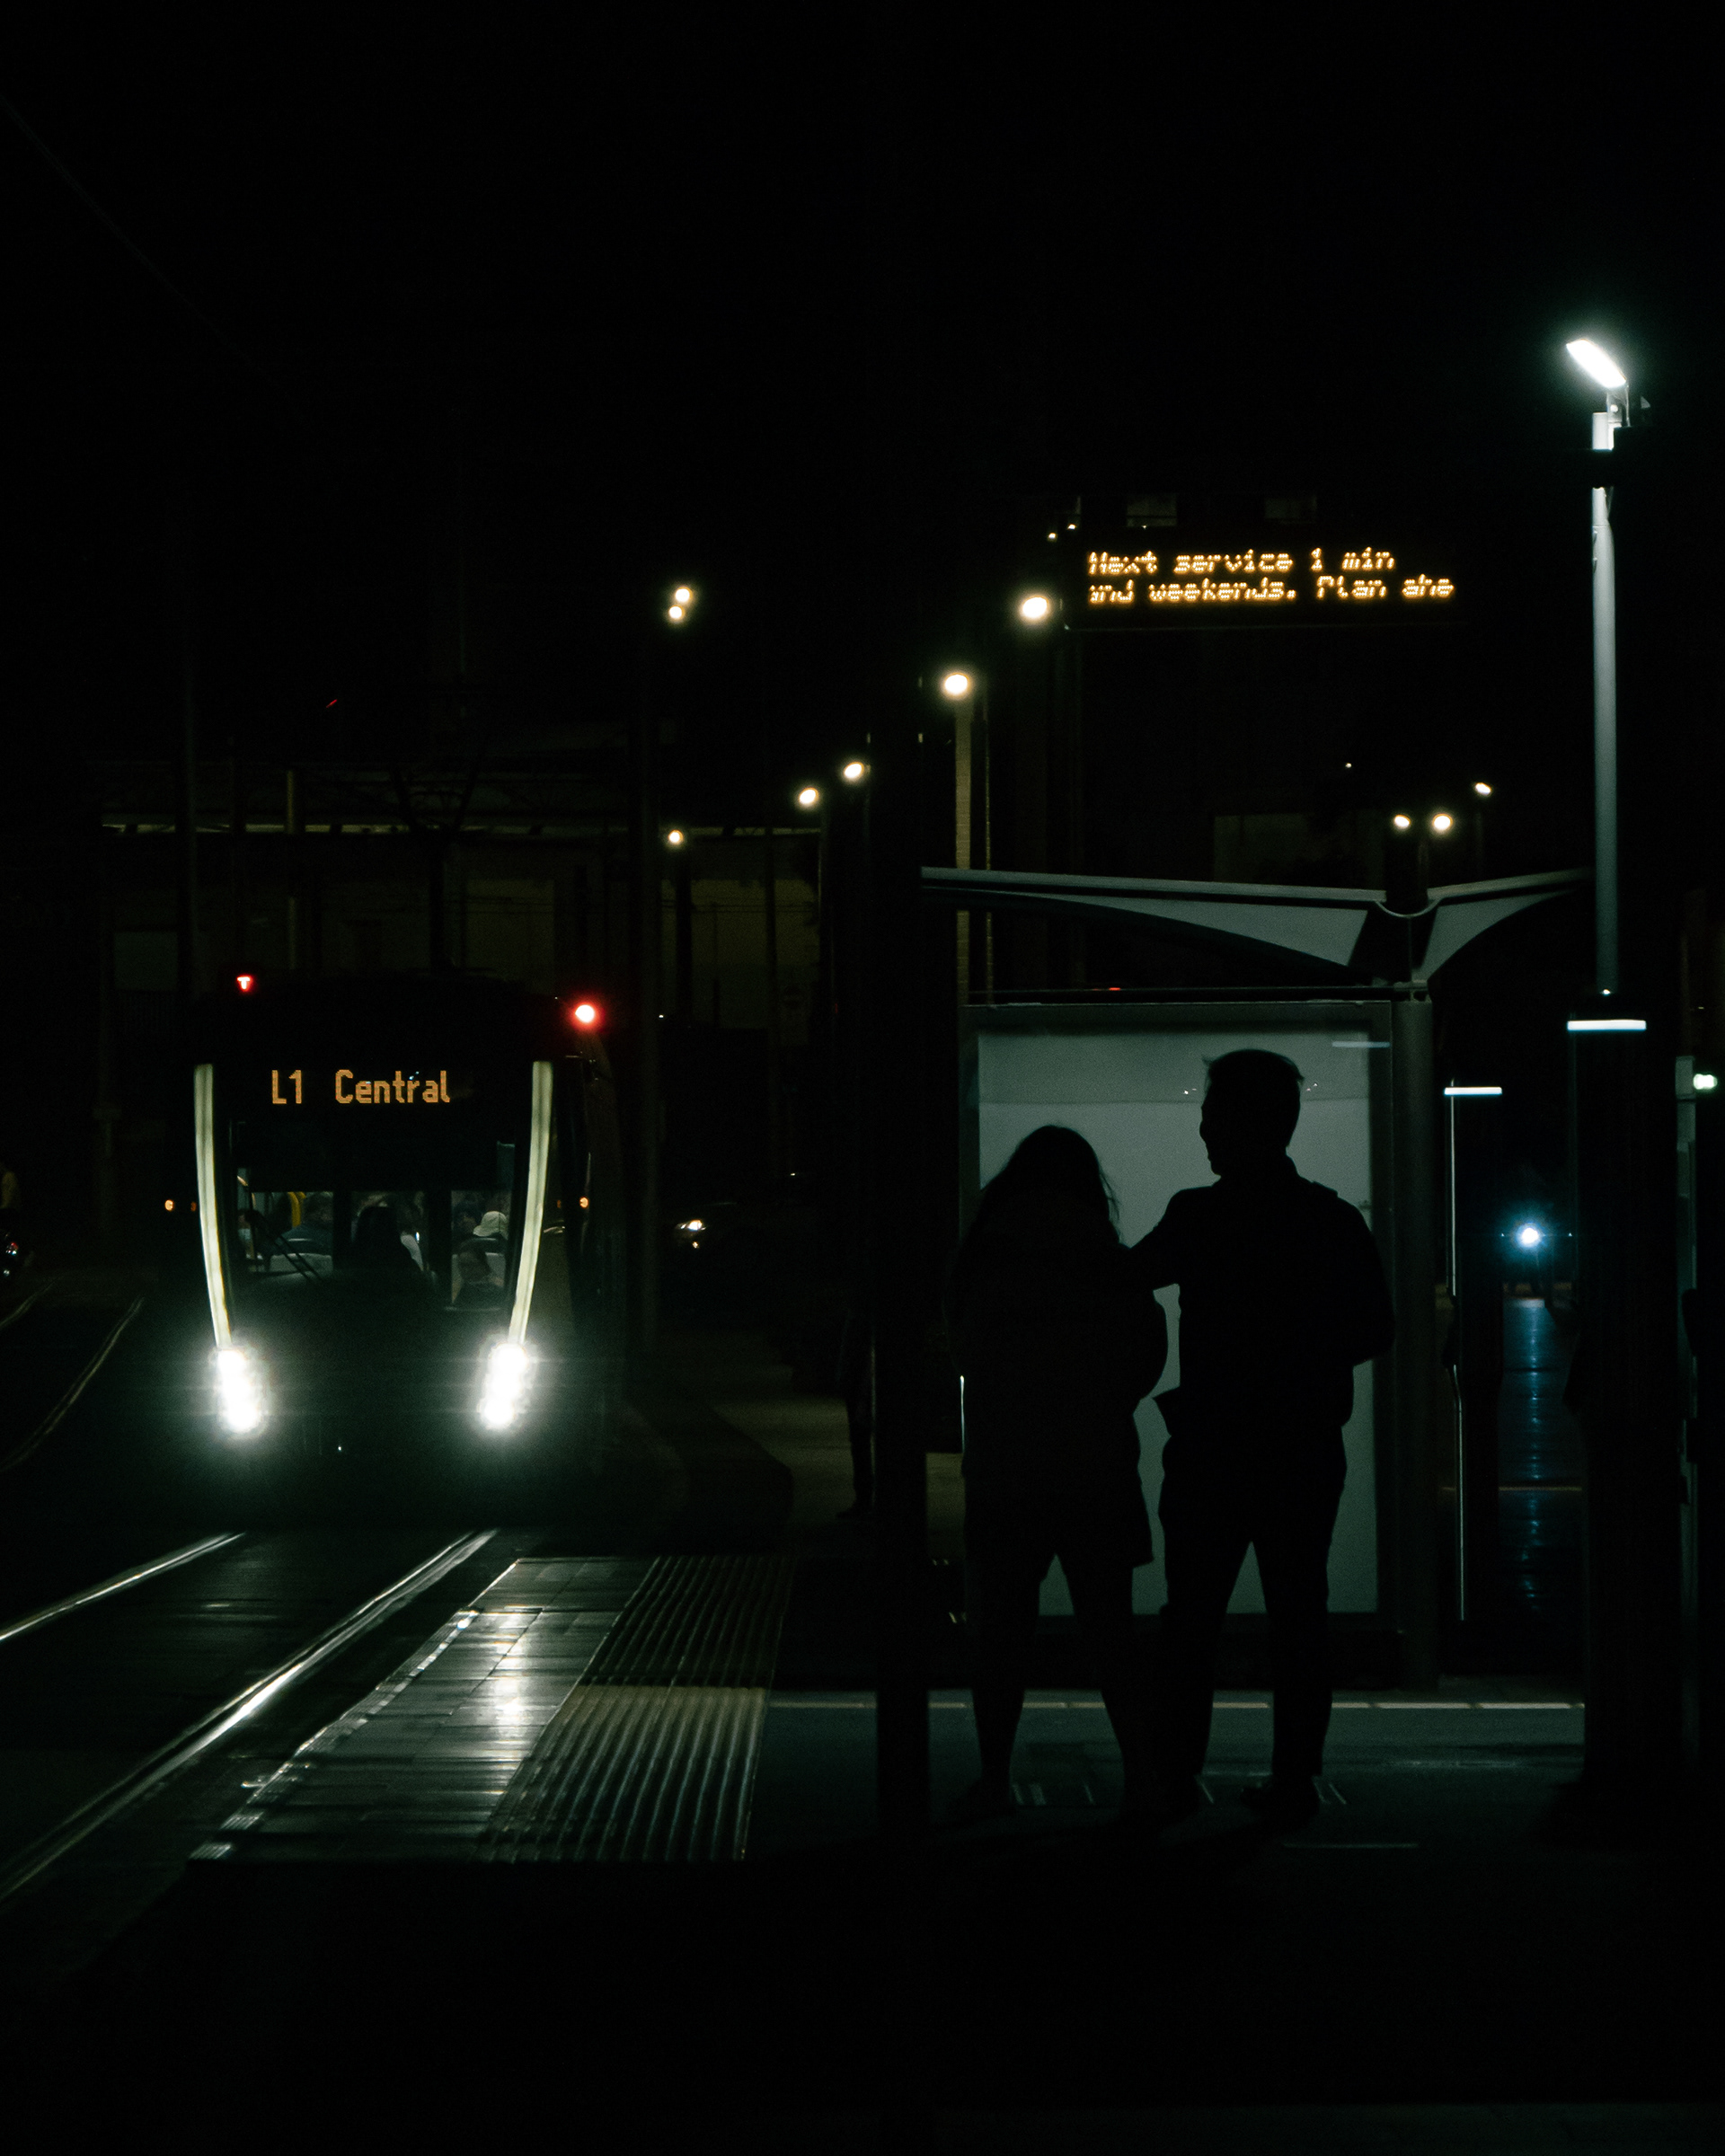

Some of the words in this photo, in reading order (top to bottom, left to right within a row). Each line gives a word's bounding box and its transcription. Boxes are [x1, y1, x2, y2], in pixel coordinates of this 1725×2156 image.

[1088, 551, 1157, 575] Next
[1173, 549, 1294, 574] service
[1311, 547, 1323, 572] 1
[1341, 546, 1394, 571] min
[1149, 577, 1296, 603] weekends.
[1317, 575, 1386, 599] Plan
[1402, 573, 1455, 599] ahe
[271, 1069, 302, 1104] L1
[335, 1069, 450, 1104] Central
